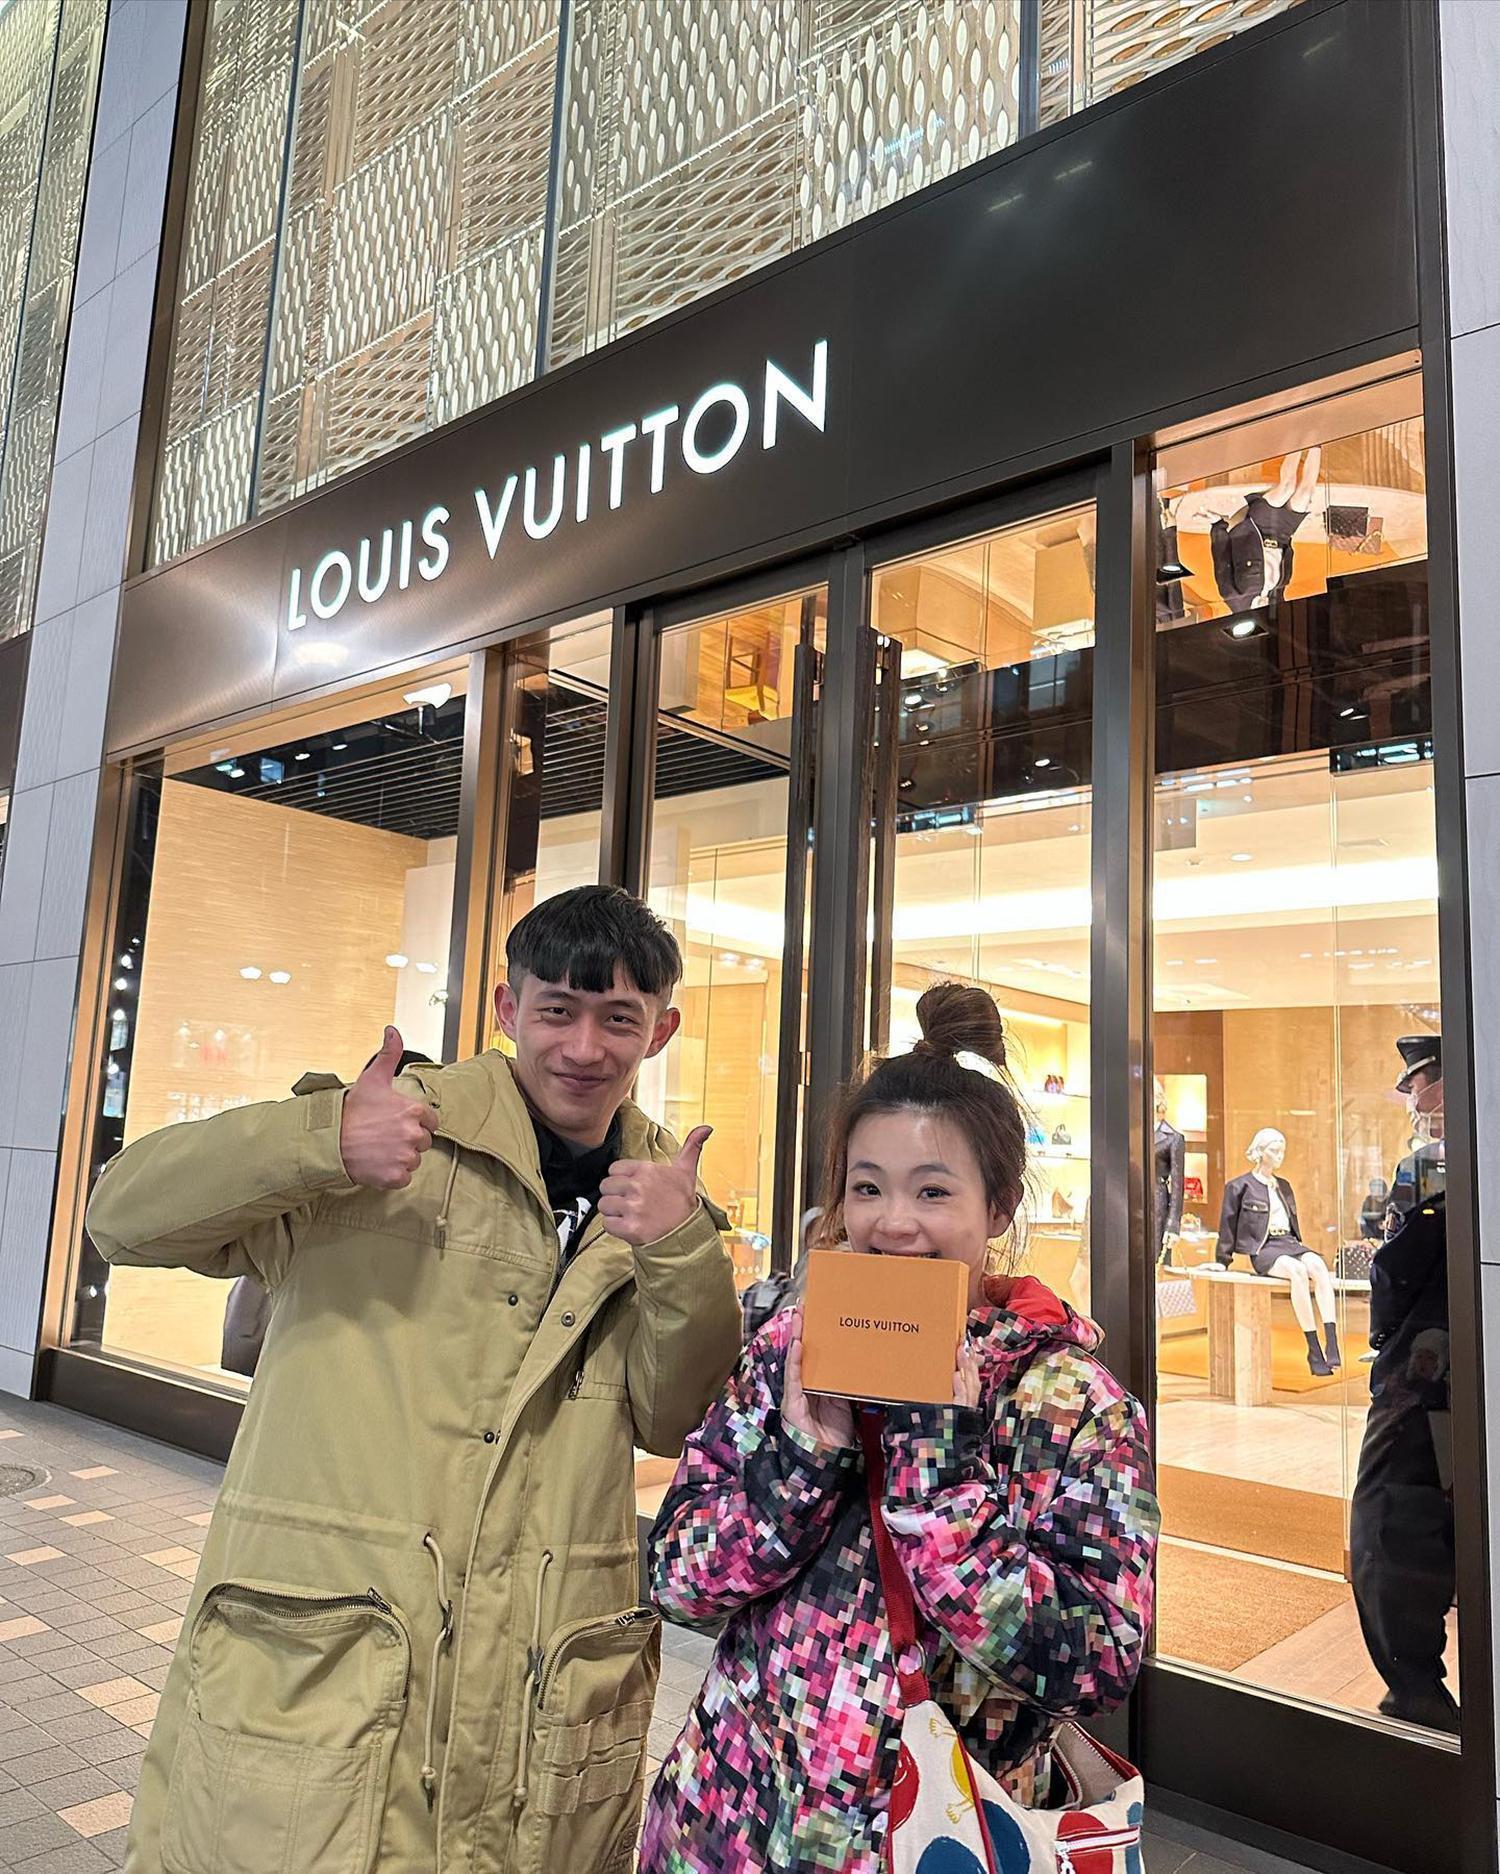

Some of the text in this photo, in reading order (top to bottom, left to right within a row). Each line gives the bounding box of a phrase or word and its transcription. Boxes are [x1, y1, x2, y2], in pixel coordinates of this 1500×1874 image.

[287, 338, 829, 631] LOUIS VUITTON
[839, 1317, 919, 1333] LOUIS VUITTON
